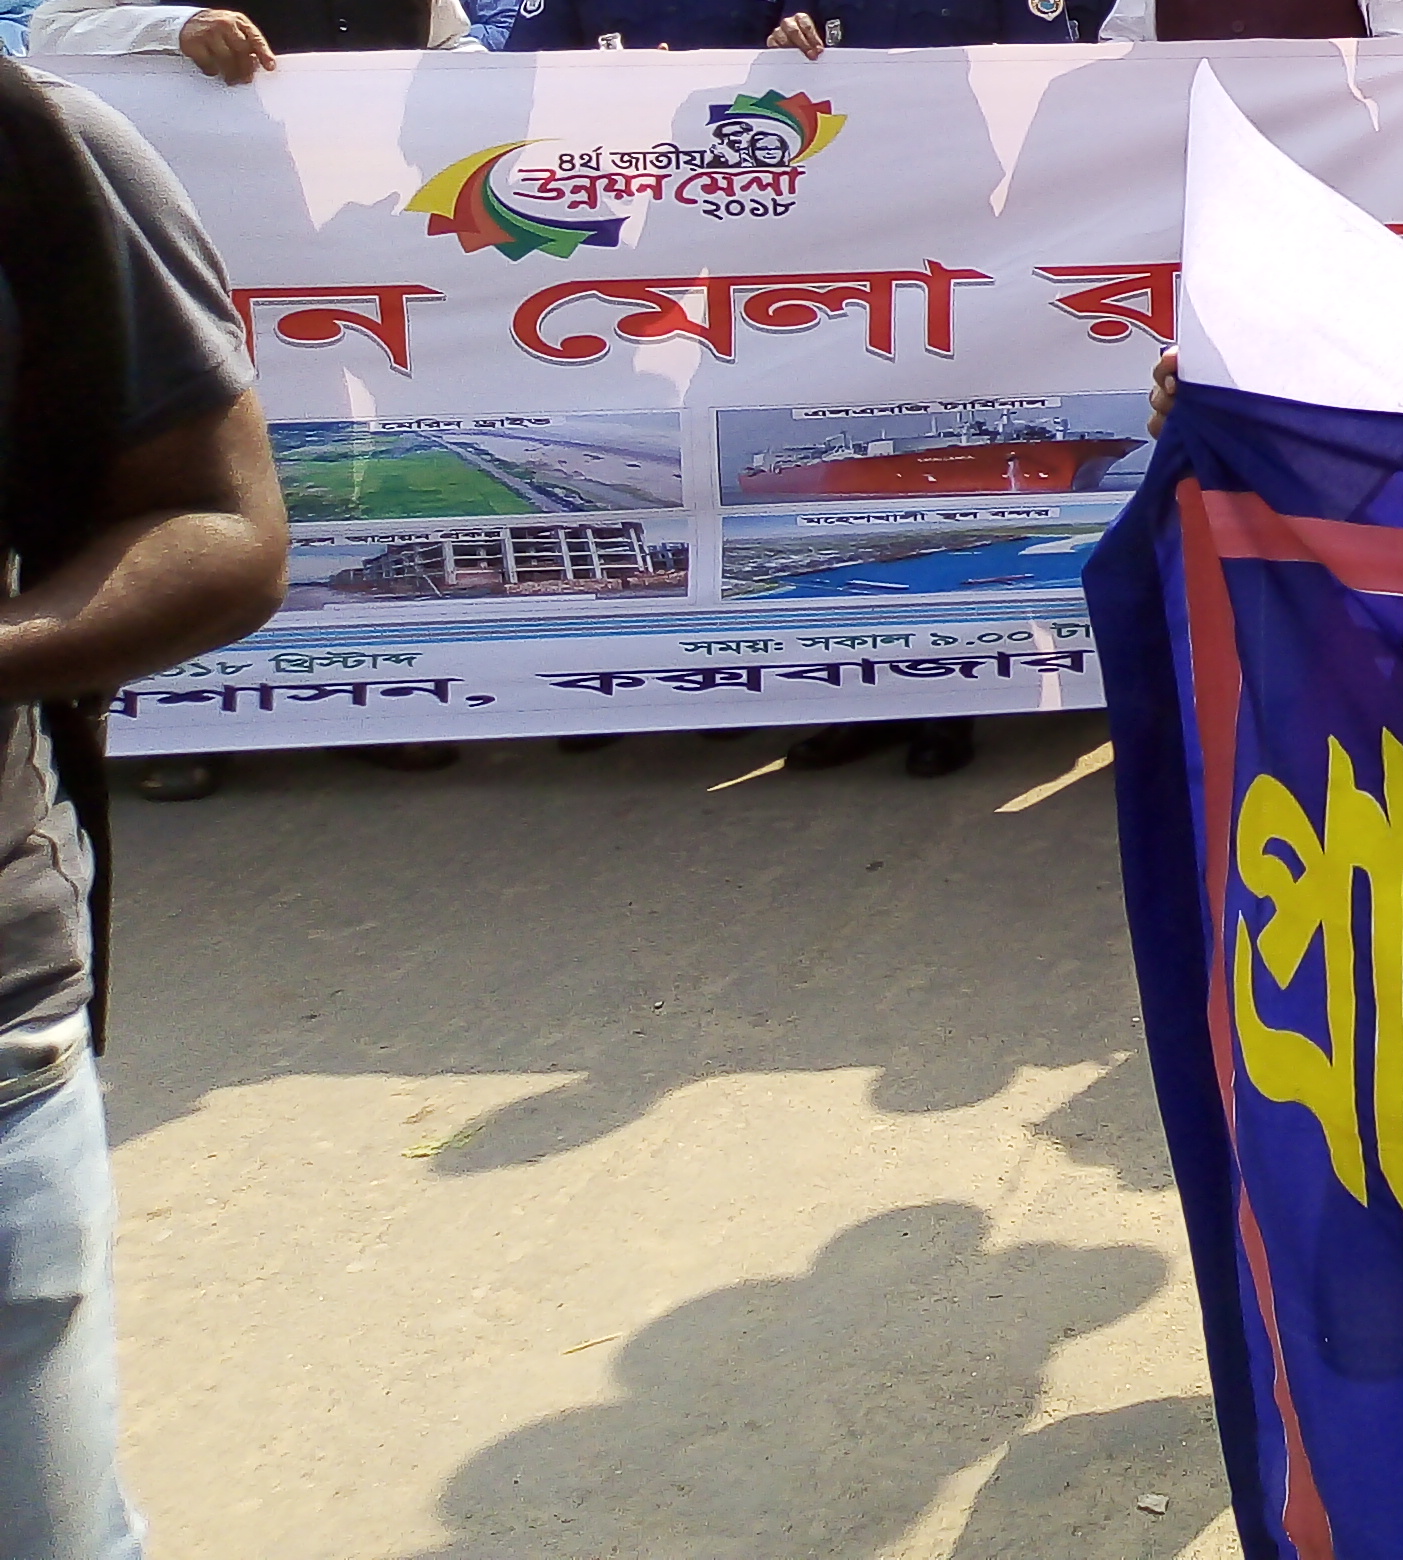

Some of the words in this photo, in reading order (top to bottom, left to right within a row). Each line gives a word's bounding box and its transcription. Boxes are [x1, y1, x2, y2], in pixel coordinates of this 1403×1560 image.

[557, 145, 603, 173] ৪র্থ
[608, 142, 707, 173] জাতীয়
[512, 167, 673, 211] উন্নয়ন
[674, 165, 807, 206] মেলা
[701, 197, 797, 221] ২০১৮
[509, 258, 995, 366] মেলা
[534, 649, 1096, 697] কক্সবাজার
